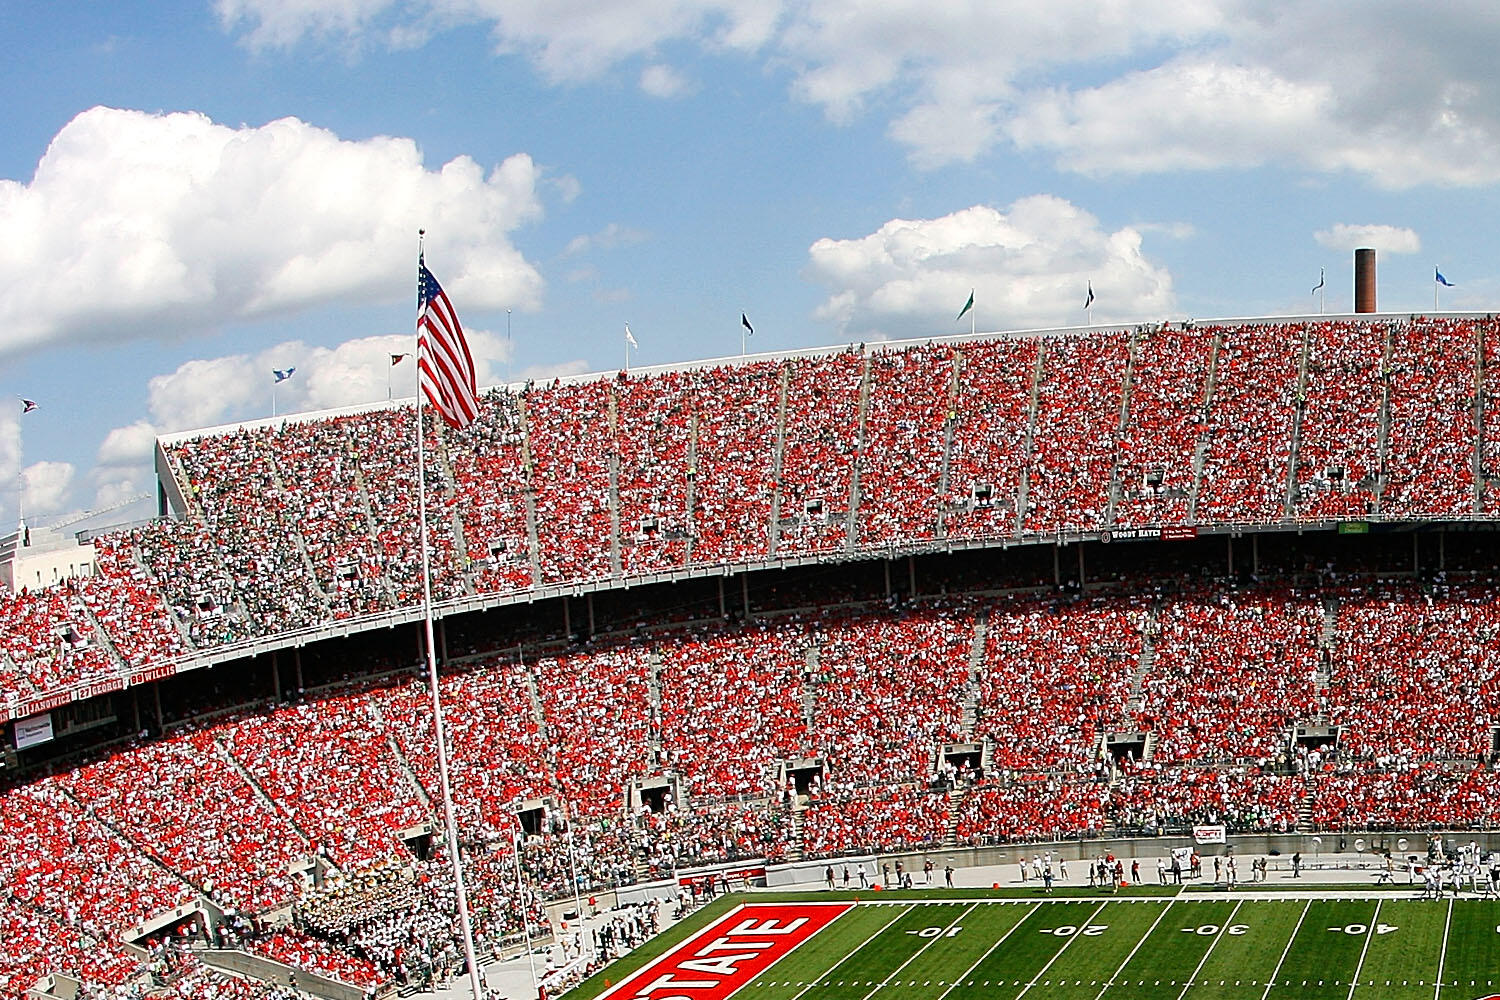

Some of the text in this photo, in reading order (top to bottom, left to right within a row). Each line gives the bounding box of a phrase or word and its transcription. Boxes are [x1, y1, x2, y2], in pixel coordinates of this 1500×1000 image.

[1112, 530, 1136, 539] WOODY
[1138, 529, 1160, 538] HAYES
[143, 665, 175, 682] WILLIS
[79, 679, 123, 699] 27 GEORGE
[30, 694, 71, 712] JANOWICZ
[1054, 924, 1108, 938] 20
[1199, 924, 1250, 936] 30
[1343, 923, 1398, 936] 40
